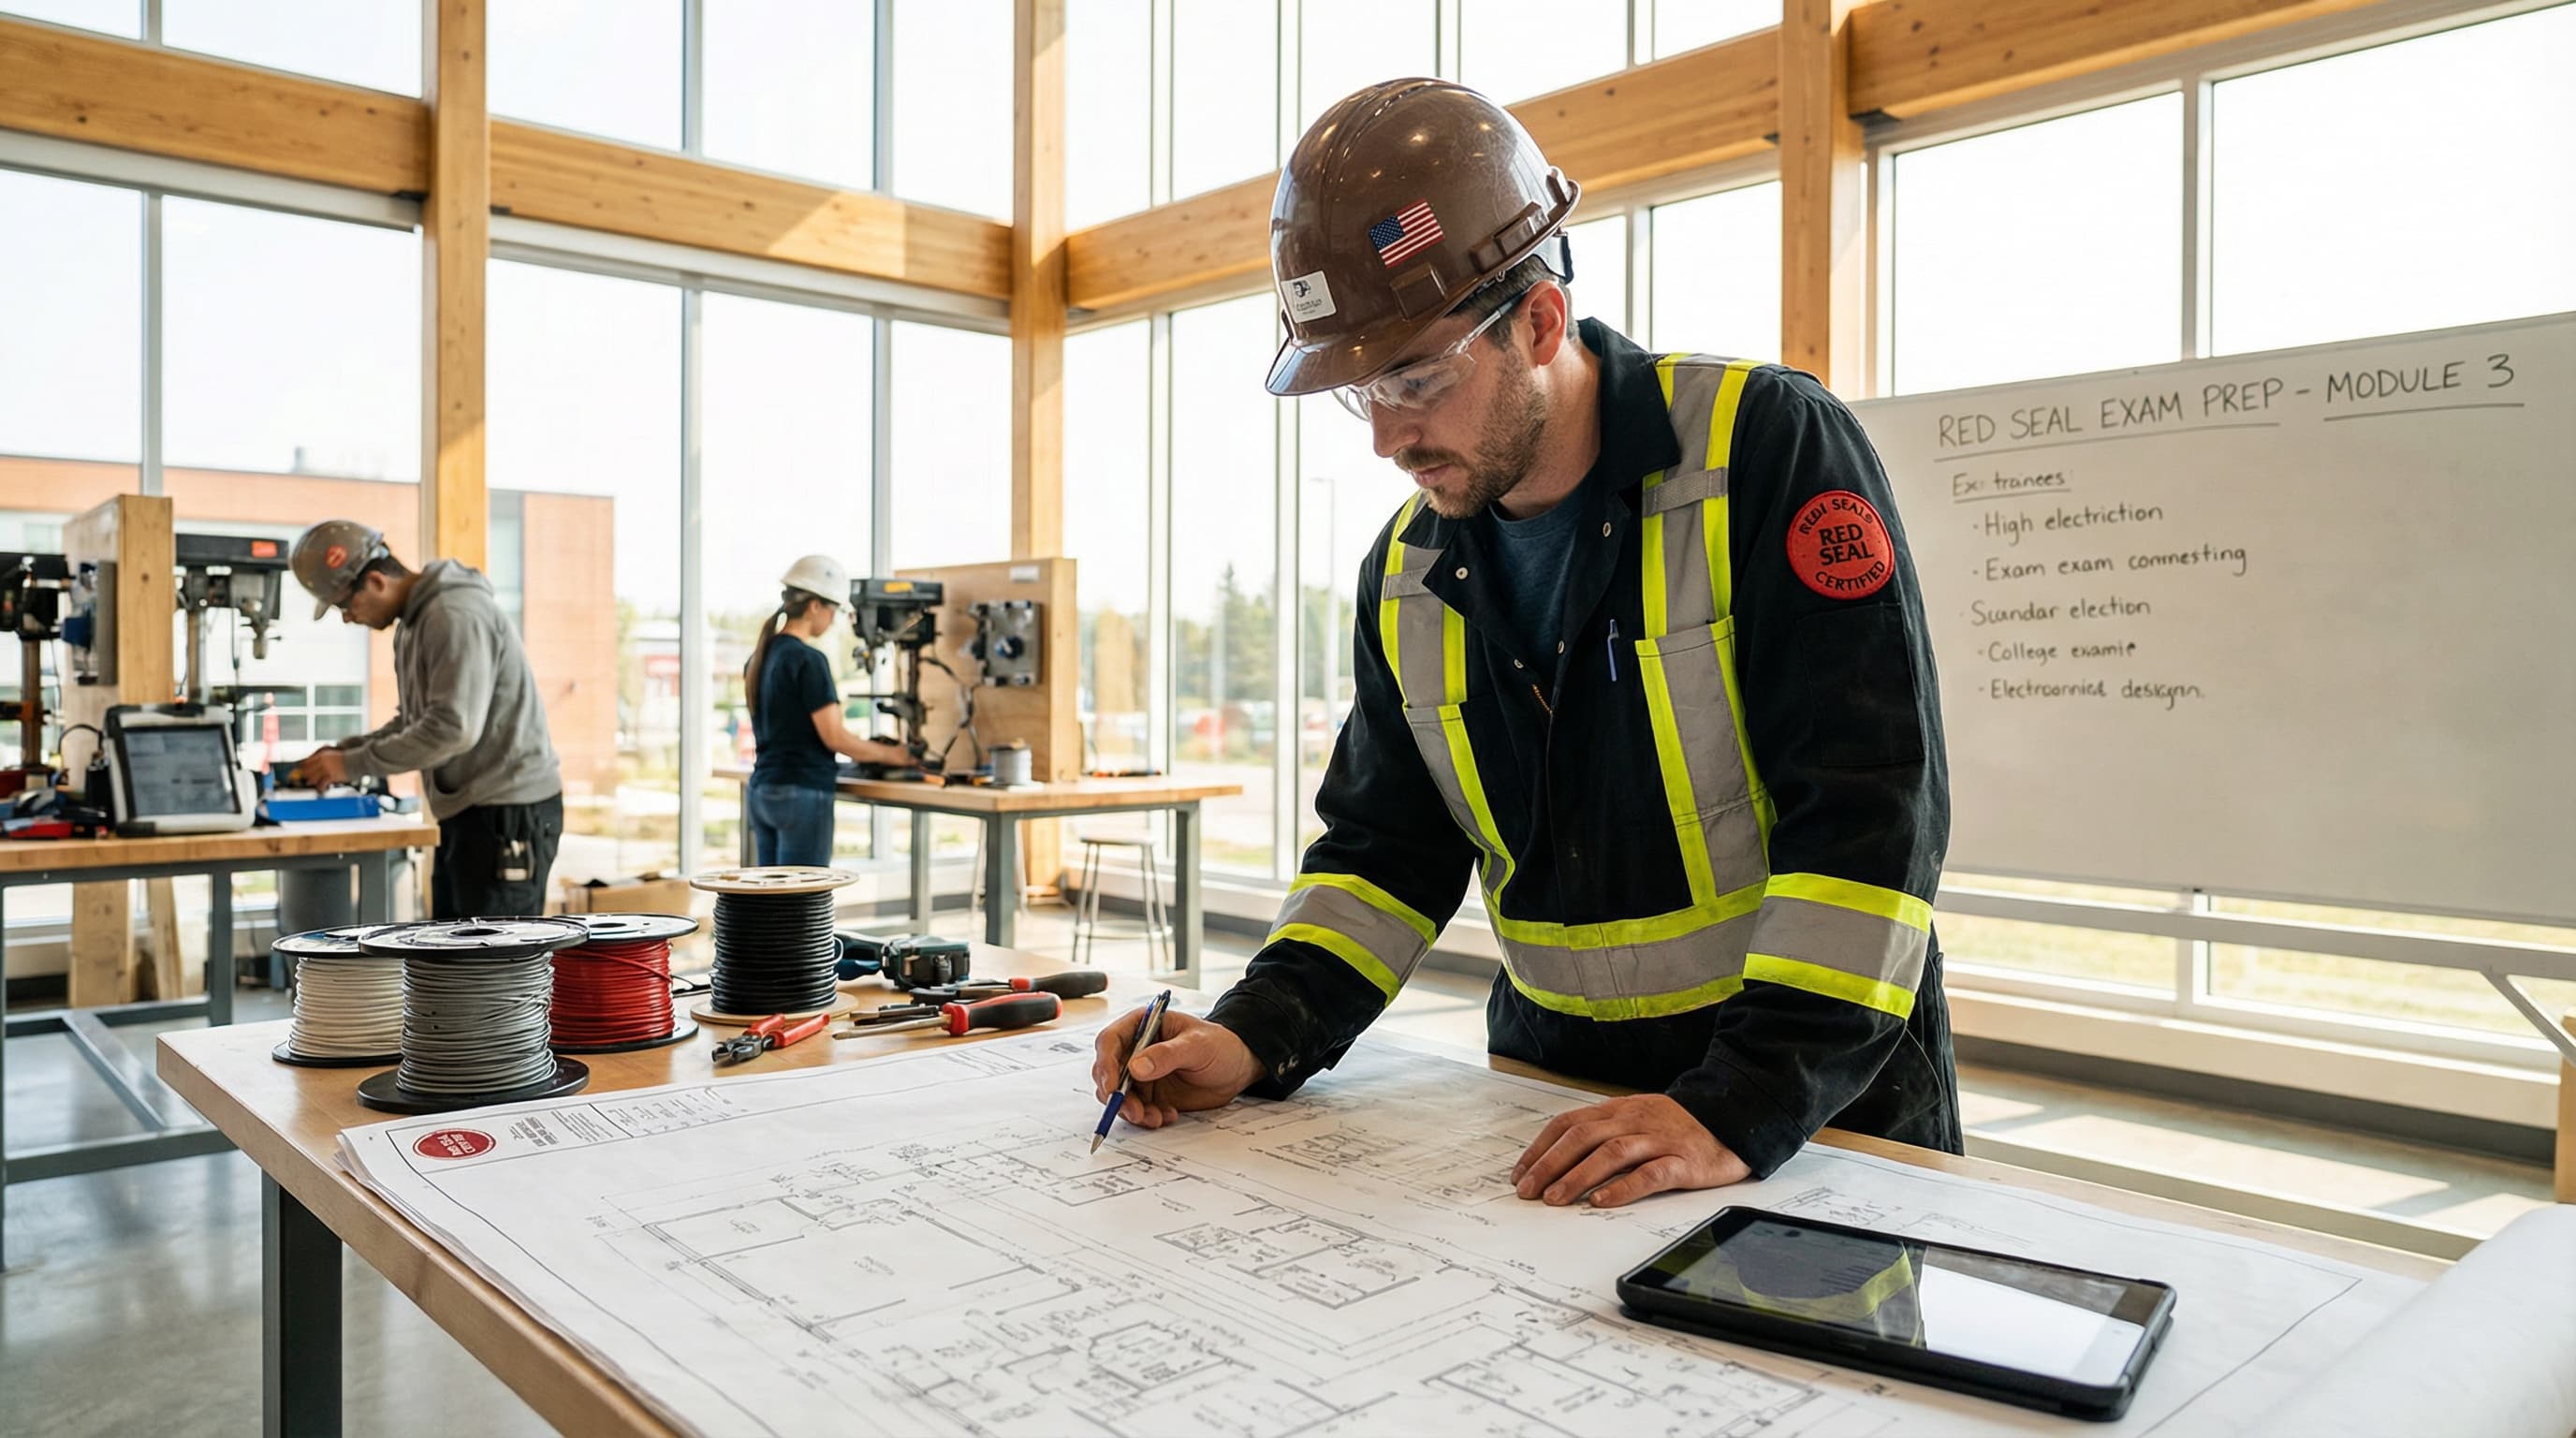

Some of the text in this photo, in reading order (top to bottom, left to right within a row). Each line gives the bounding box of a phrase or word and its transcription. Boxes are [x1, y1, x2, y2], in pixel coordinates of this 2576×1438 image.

[1939, 414, 1996, 448] RED
[2011, 406, 2083, 440] SEAL
[2100, 391, 2184, 429] EXAM
[2203, 377, 2284, 418] PREP
[2327, 360, 2466, 404] MODULE
[2487, 353, 2515, 388] 3
[1818, 522, 1864, 547] RED
[1984, 511, 2033, 547] High
[1819, 540, 1875, 566] SEAL
[1815, 560, 1885, 592] CERTIFIED
[1985, 557, 2046, 581] Exam
[2057, 557, 2115, 574] exam
[2070, 595, 2151, 619] election
[1988, 640, 2057, 667] College
